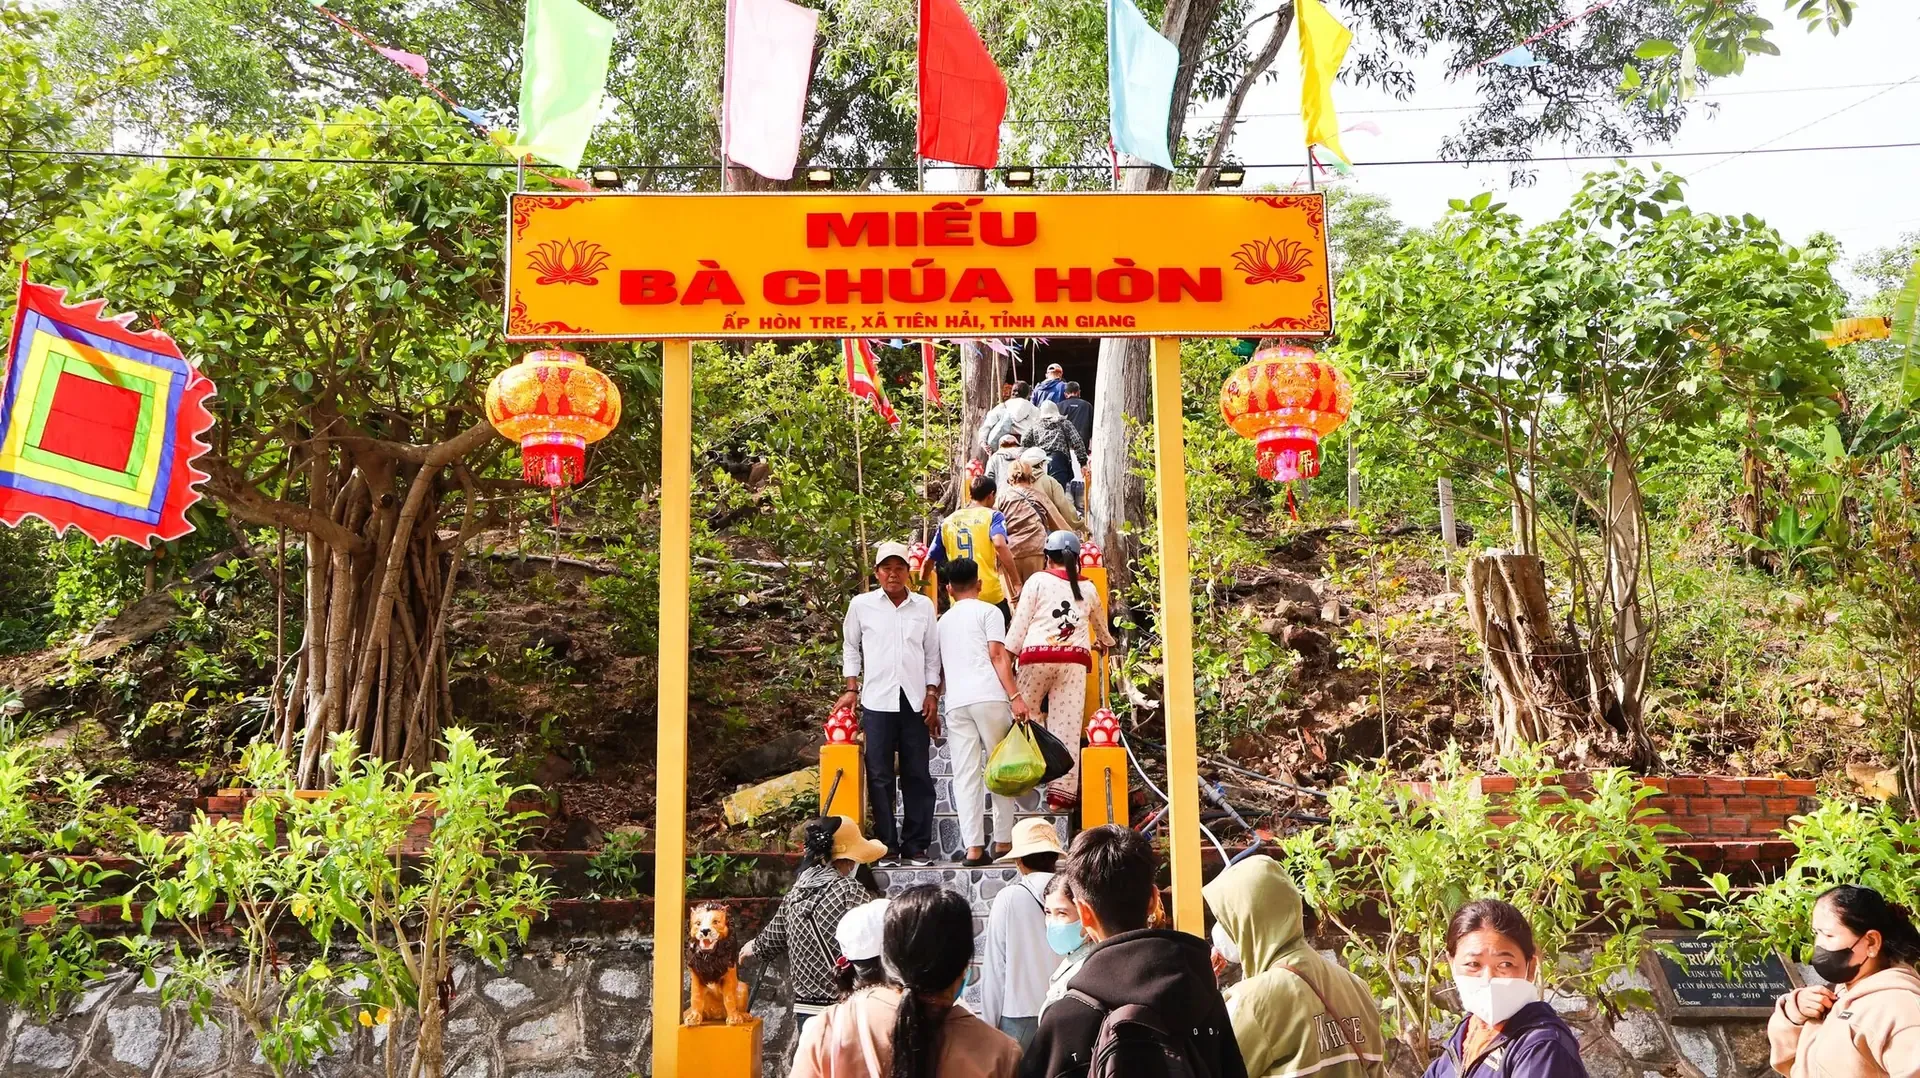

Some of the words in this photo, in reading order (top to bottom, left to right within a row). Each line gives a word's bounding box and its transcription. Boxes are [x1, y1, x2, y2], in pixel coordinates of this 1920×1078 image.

[806, 198, 1038, 248] MIẾU
[619, 259, 745, 306] BÀ
[762, 257, 1014, 306] CHÚA
[1034, 258, 1223, 304] HÒN
[722, 312, 750, 330] ẤP
[759, 313, 801, 330] HÒN
[808, 316, 856, 331] TRE,
[861, 312, 888, 329] XÃ
[893, 313, 938, 329] TIÊN
[945, 311, 986, 331] HẢI,
[989, 311, 1036, 328] TỈNH
[1041, 315, 1069, 328] AN
[1074, 315, 1136, 328] GIANG
[957, 528, 973, 560] 9
